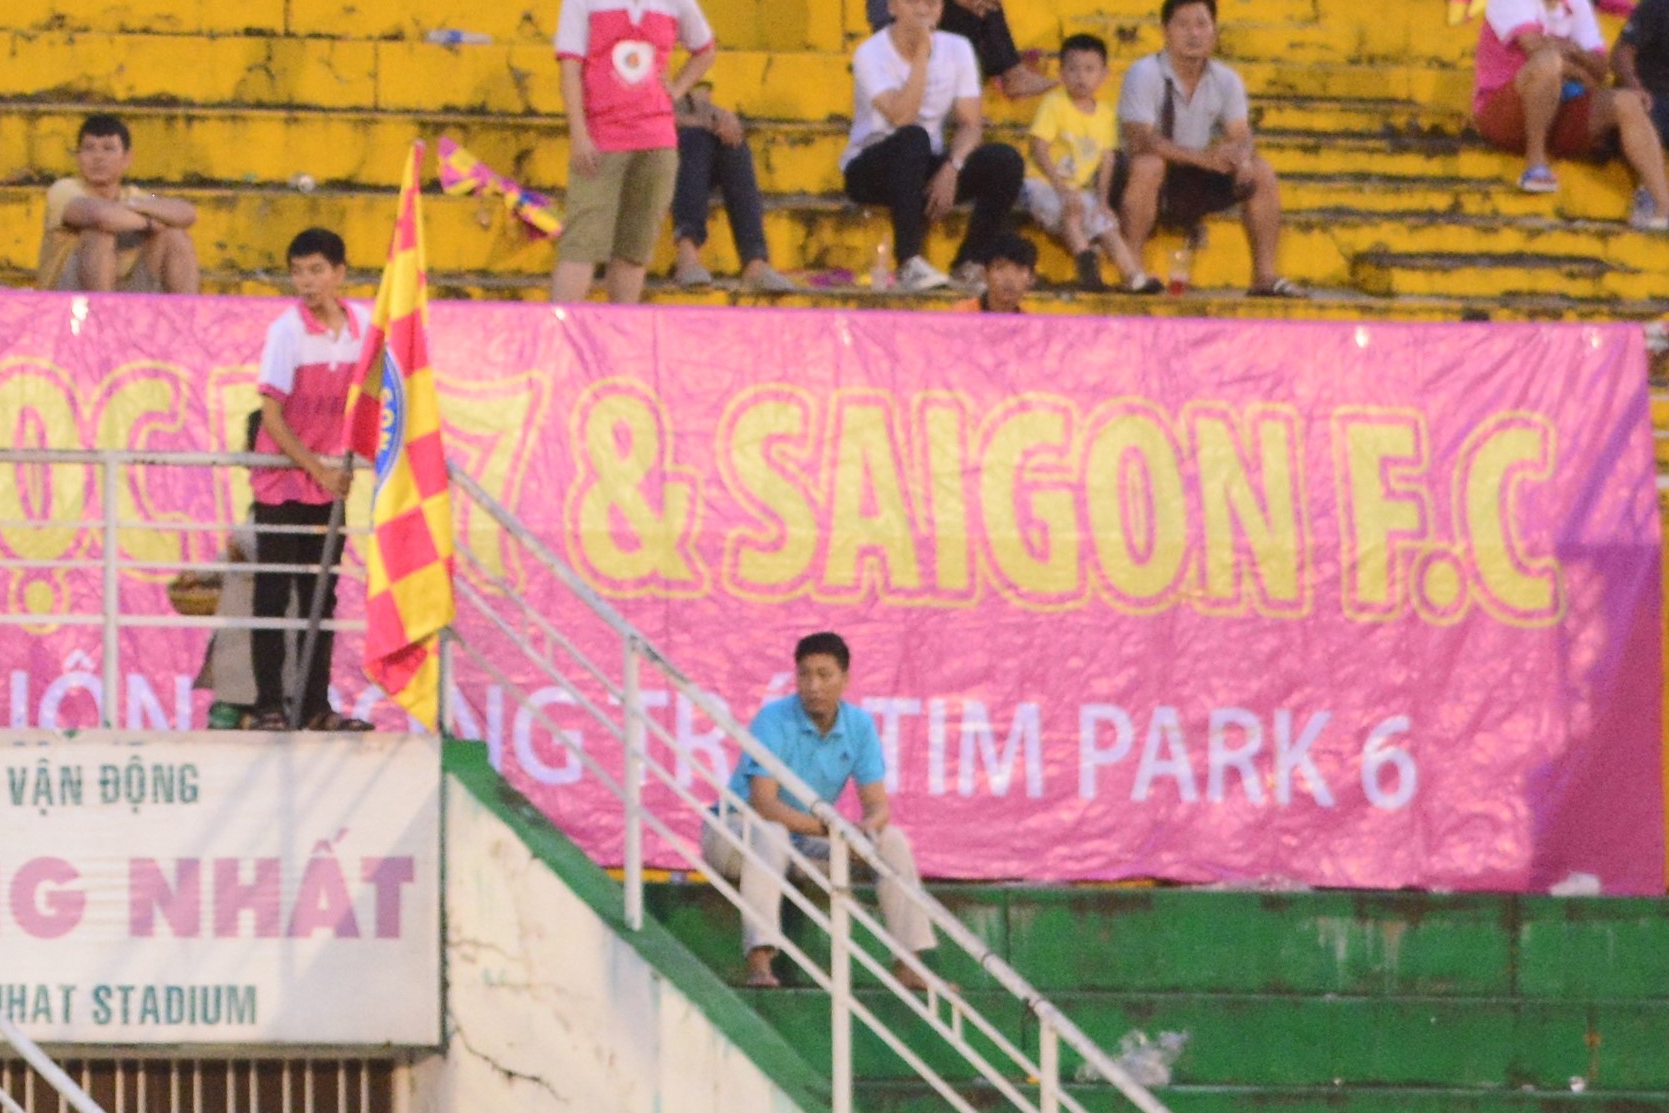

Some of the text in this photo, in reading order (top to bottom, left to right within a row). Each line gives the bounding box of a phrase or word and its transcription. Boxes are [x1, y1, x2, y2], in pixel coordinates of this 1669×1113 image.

[565, 376, 714, 600] &
[720, 383, 1314, 618] SAIGON
[1331, 403, 1566, 628] F.C
[7, 757, 84, 816] VẬN
[98, 754, 200, 814] ĐỘNG
[861, 696, 1046, 800] TIM
[1077, 702, 1337, 808] PARK
[1360, 715, 1420, 811] 6
[128, 828, 416, 941] NHẤT
[92, 983, 259, 1027] STADIUM
